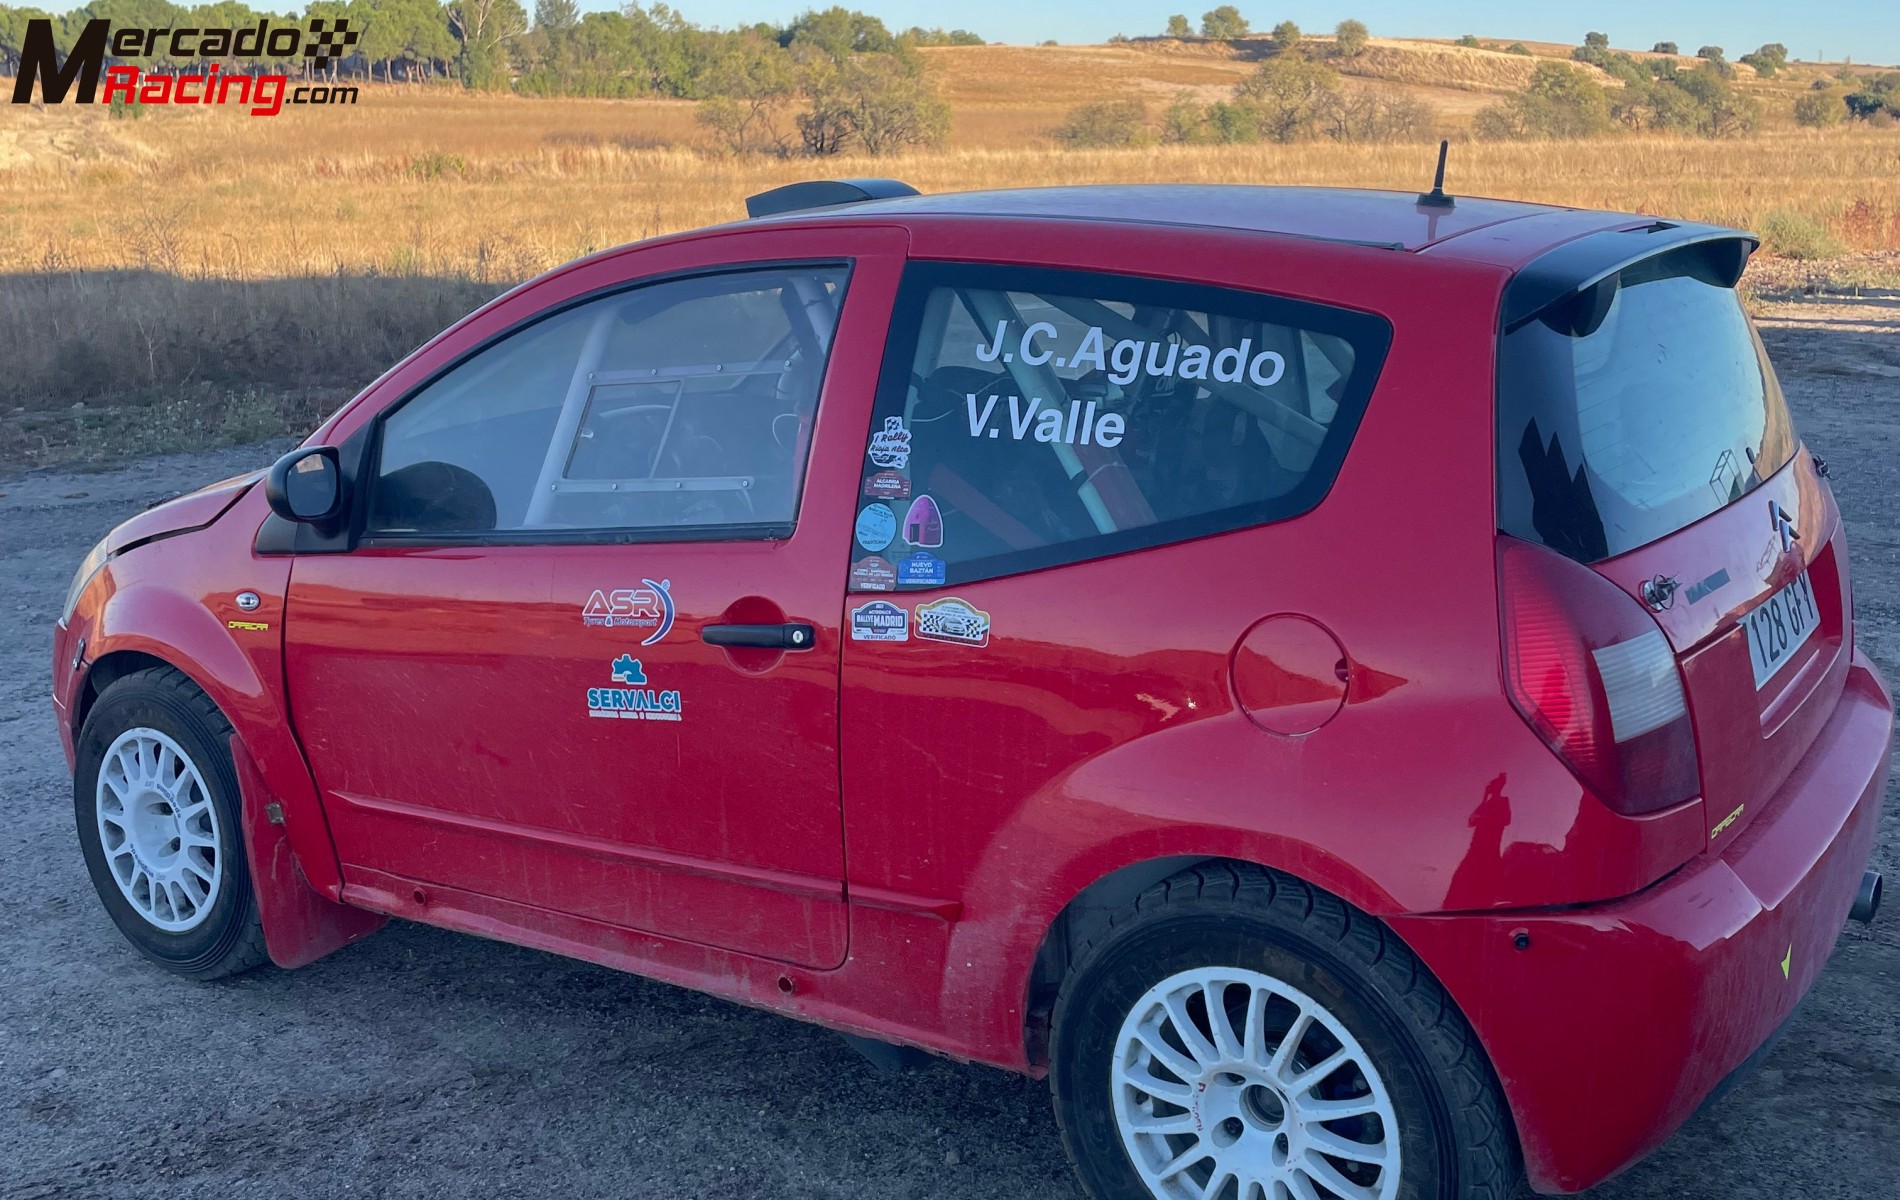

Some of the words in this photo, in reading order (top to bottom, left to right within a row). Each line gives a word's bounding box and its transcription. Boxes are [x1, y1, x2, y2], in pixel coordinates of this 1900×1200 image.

[976, 320, 1285, 386] J.C.Aguado
[966, 393, 1126, 448] V.Valle
[881, 431, 909, 442] Rally
[870, 445, 890, 454] Rioja
[582, 589, 660, 617] ASR
[605, 616, 613, 627] &
[614, 617, 658, 628] Motorsport
[874, 615, 903, 627] MADRID
[1743, 598, 1787, 668] 128
[587, 688, 681, 712] SERVALCI
